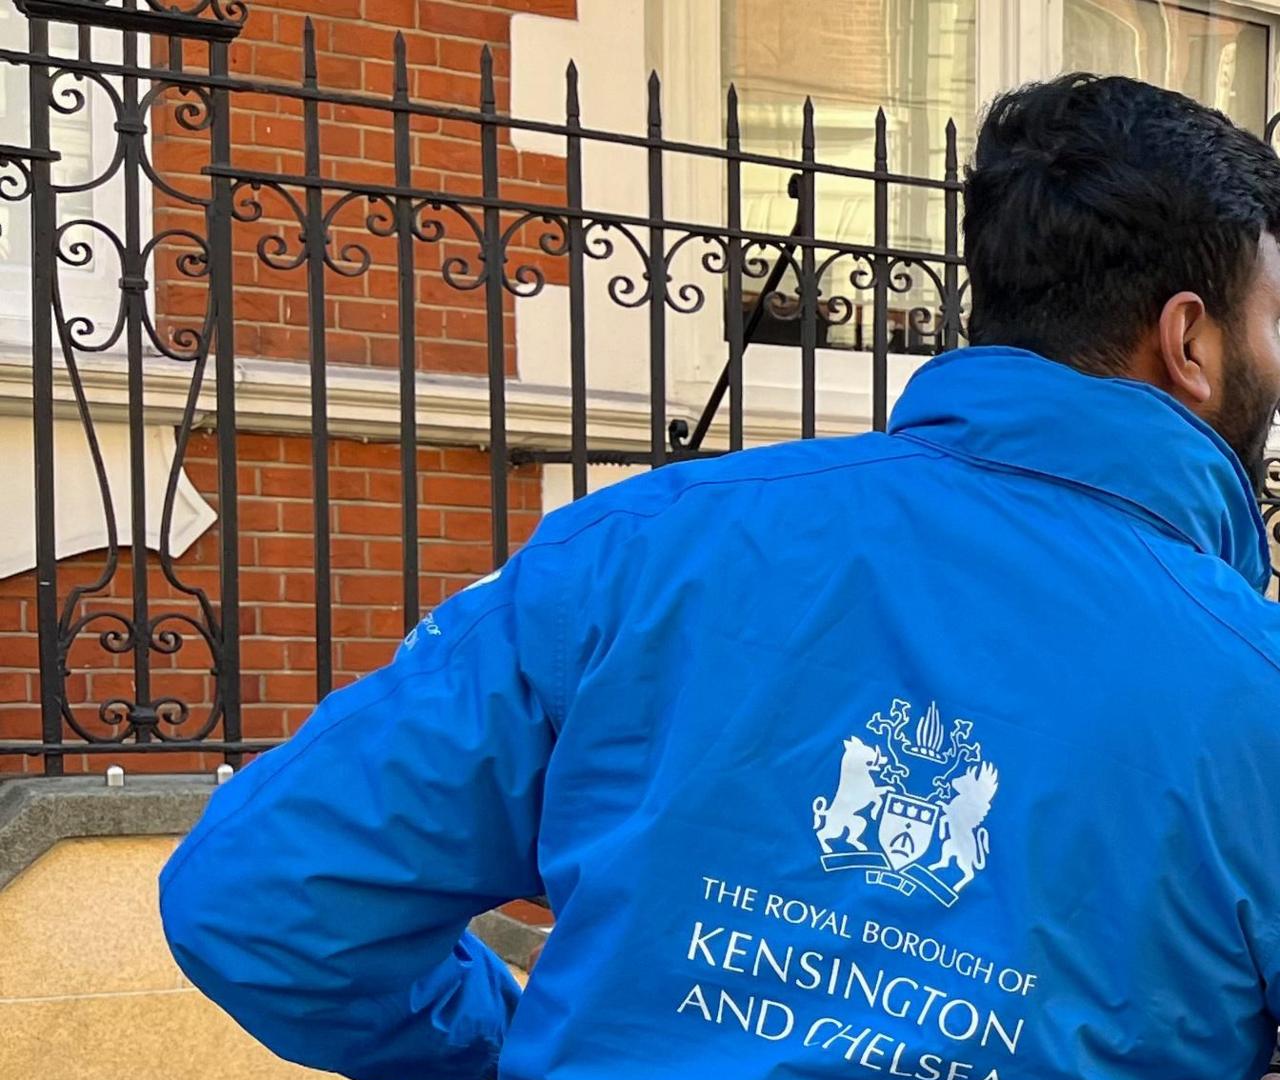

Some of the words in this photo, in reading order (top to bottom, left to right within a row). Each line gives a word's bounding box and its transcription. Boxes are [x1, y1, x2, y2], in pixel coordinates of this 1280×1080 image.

[687, 922, 1024, 1055] KENSINGTON
[702, 877, 757, 911] THE
[766, 896, 851, 938] ROYAL
[863, 921, 993, 984] BOROUGH
[999, 969, 1037, 997] OF
[677, 984, 794, 1041] AND
